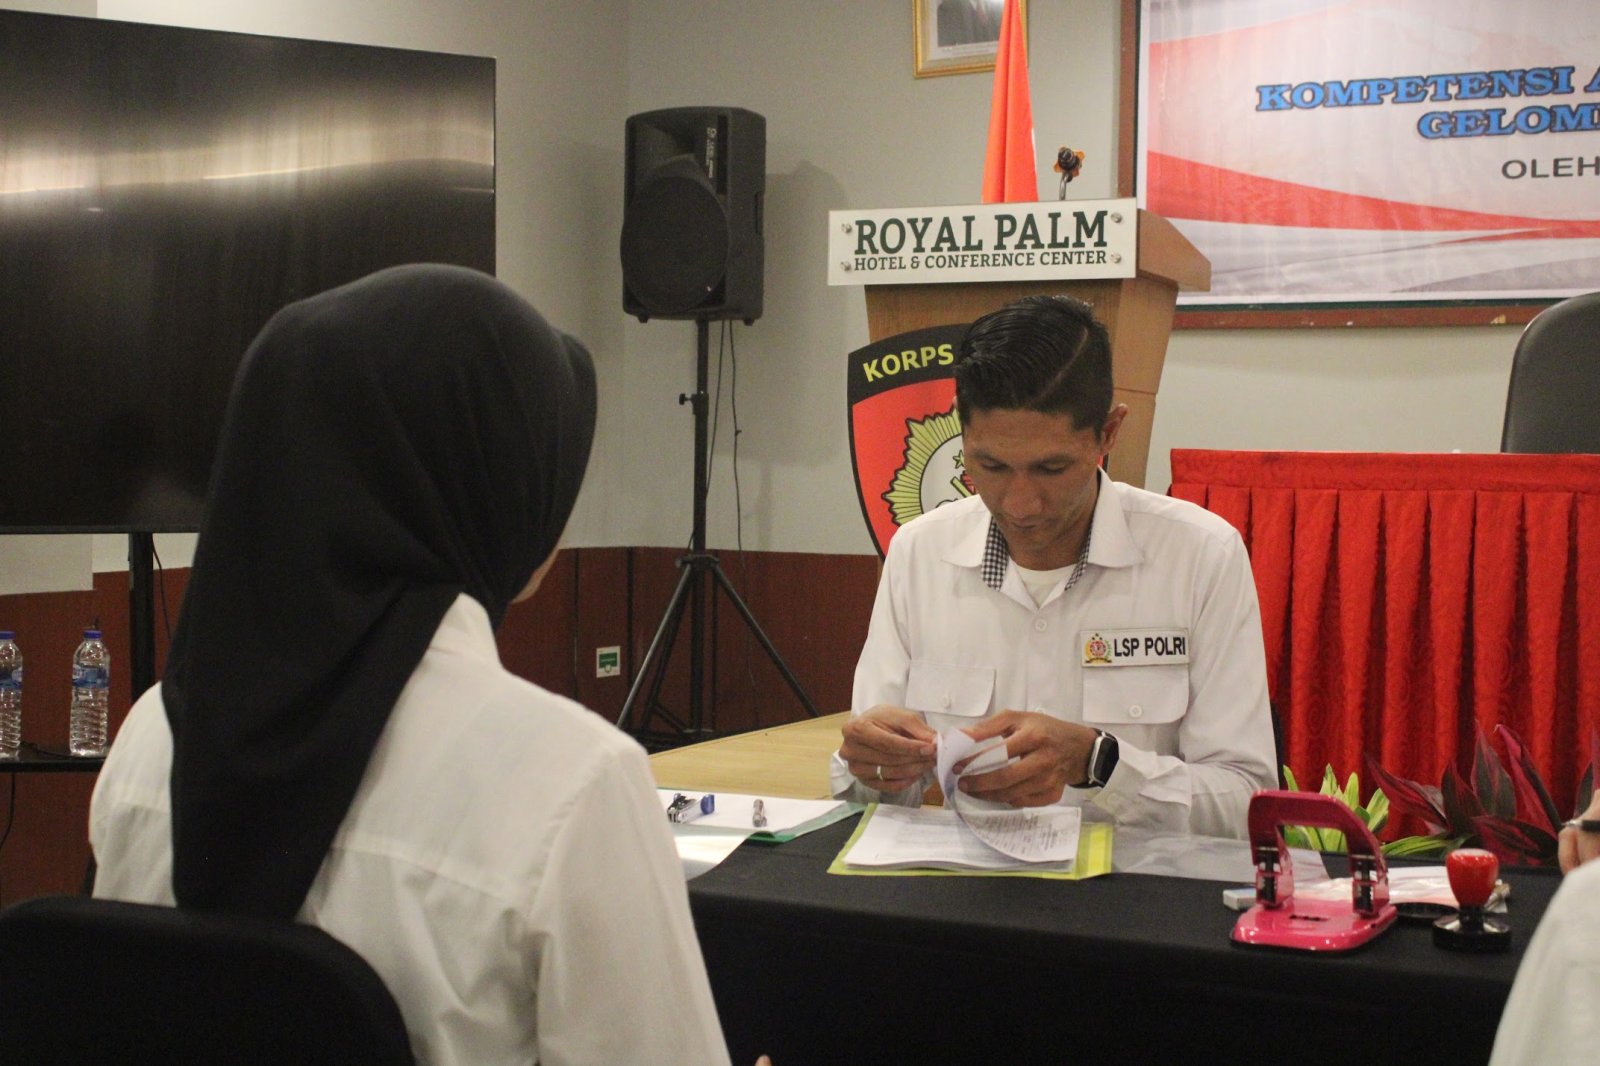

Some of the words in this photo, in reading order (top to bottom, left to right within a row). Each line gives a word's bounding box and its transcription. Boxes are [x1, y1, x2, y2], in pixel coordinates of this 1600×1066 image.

[1256, 65, 1575, 111] KOMPETENSI
[1417, 102, 1600, 139] GELOM
[1501, 156, 1600, 180] OLEH
[854, 215, 983, 255] ROYAL
[994, 210, 1108, 250] PALM
[854, 256, 906, 271] HOTEL
[910, 255, 920, 269] &
[924, 252, 1035, 269] CONFERENCE
[1039, 250, 1107, 265] CENTER
[863, 344, 954, 383] KORPS
[1114, 637, 1140, 657] LSP
[1144, 636, 1186, 656] POLRI
